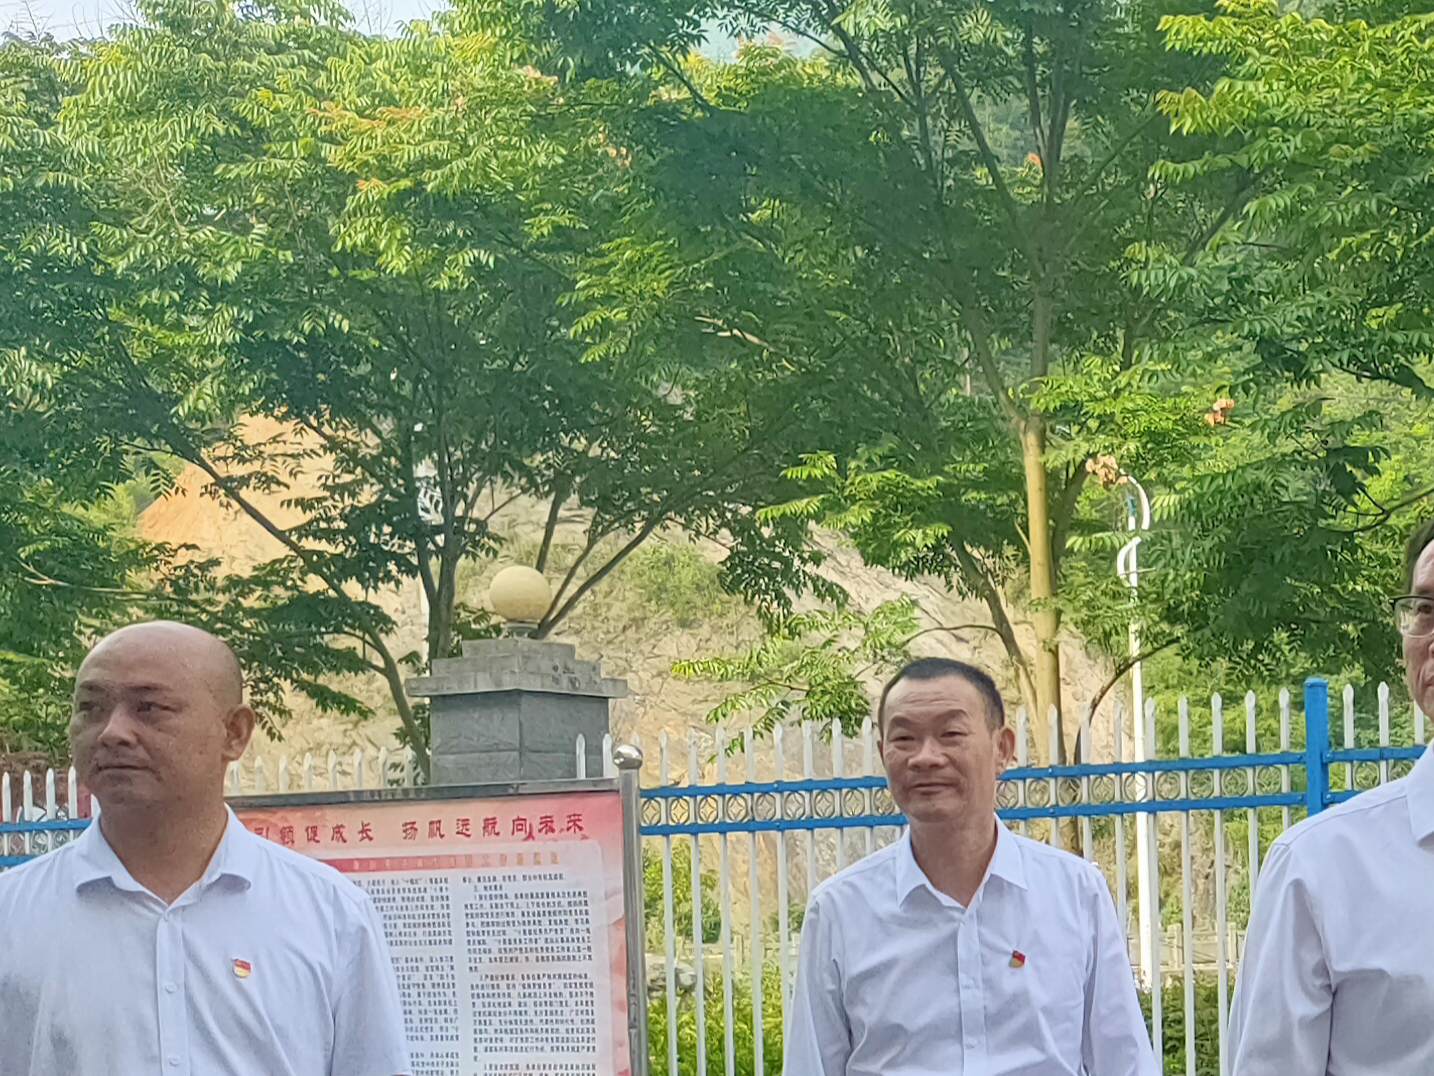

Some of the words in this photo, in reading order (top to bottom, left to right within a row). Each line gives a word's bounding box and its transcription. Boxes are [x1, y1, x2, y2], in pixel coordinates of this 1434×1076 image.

[402, 813, 584, 841] 扬帆远航向未来
